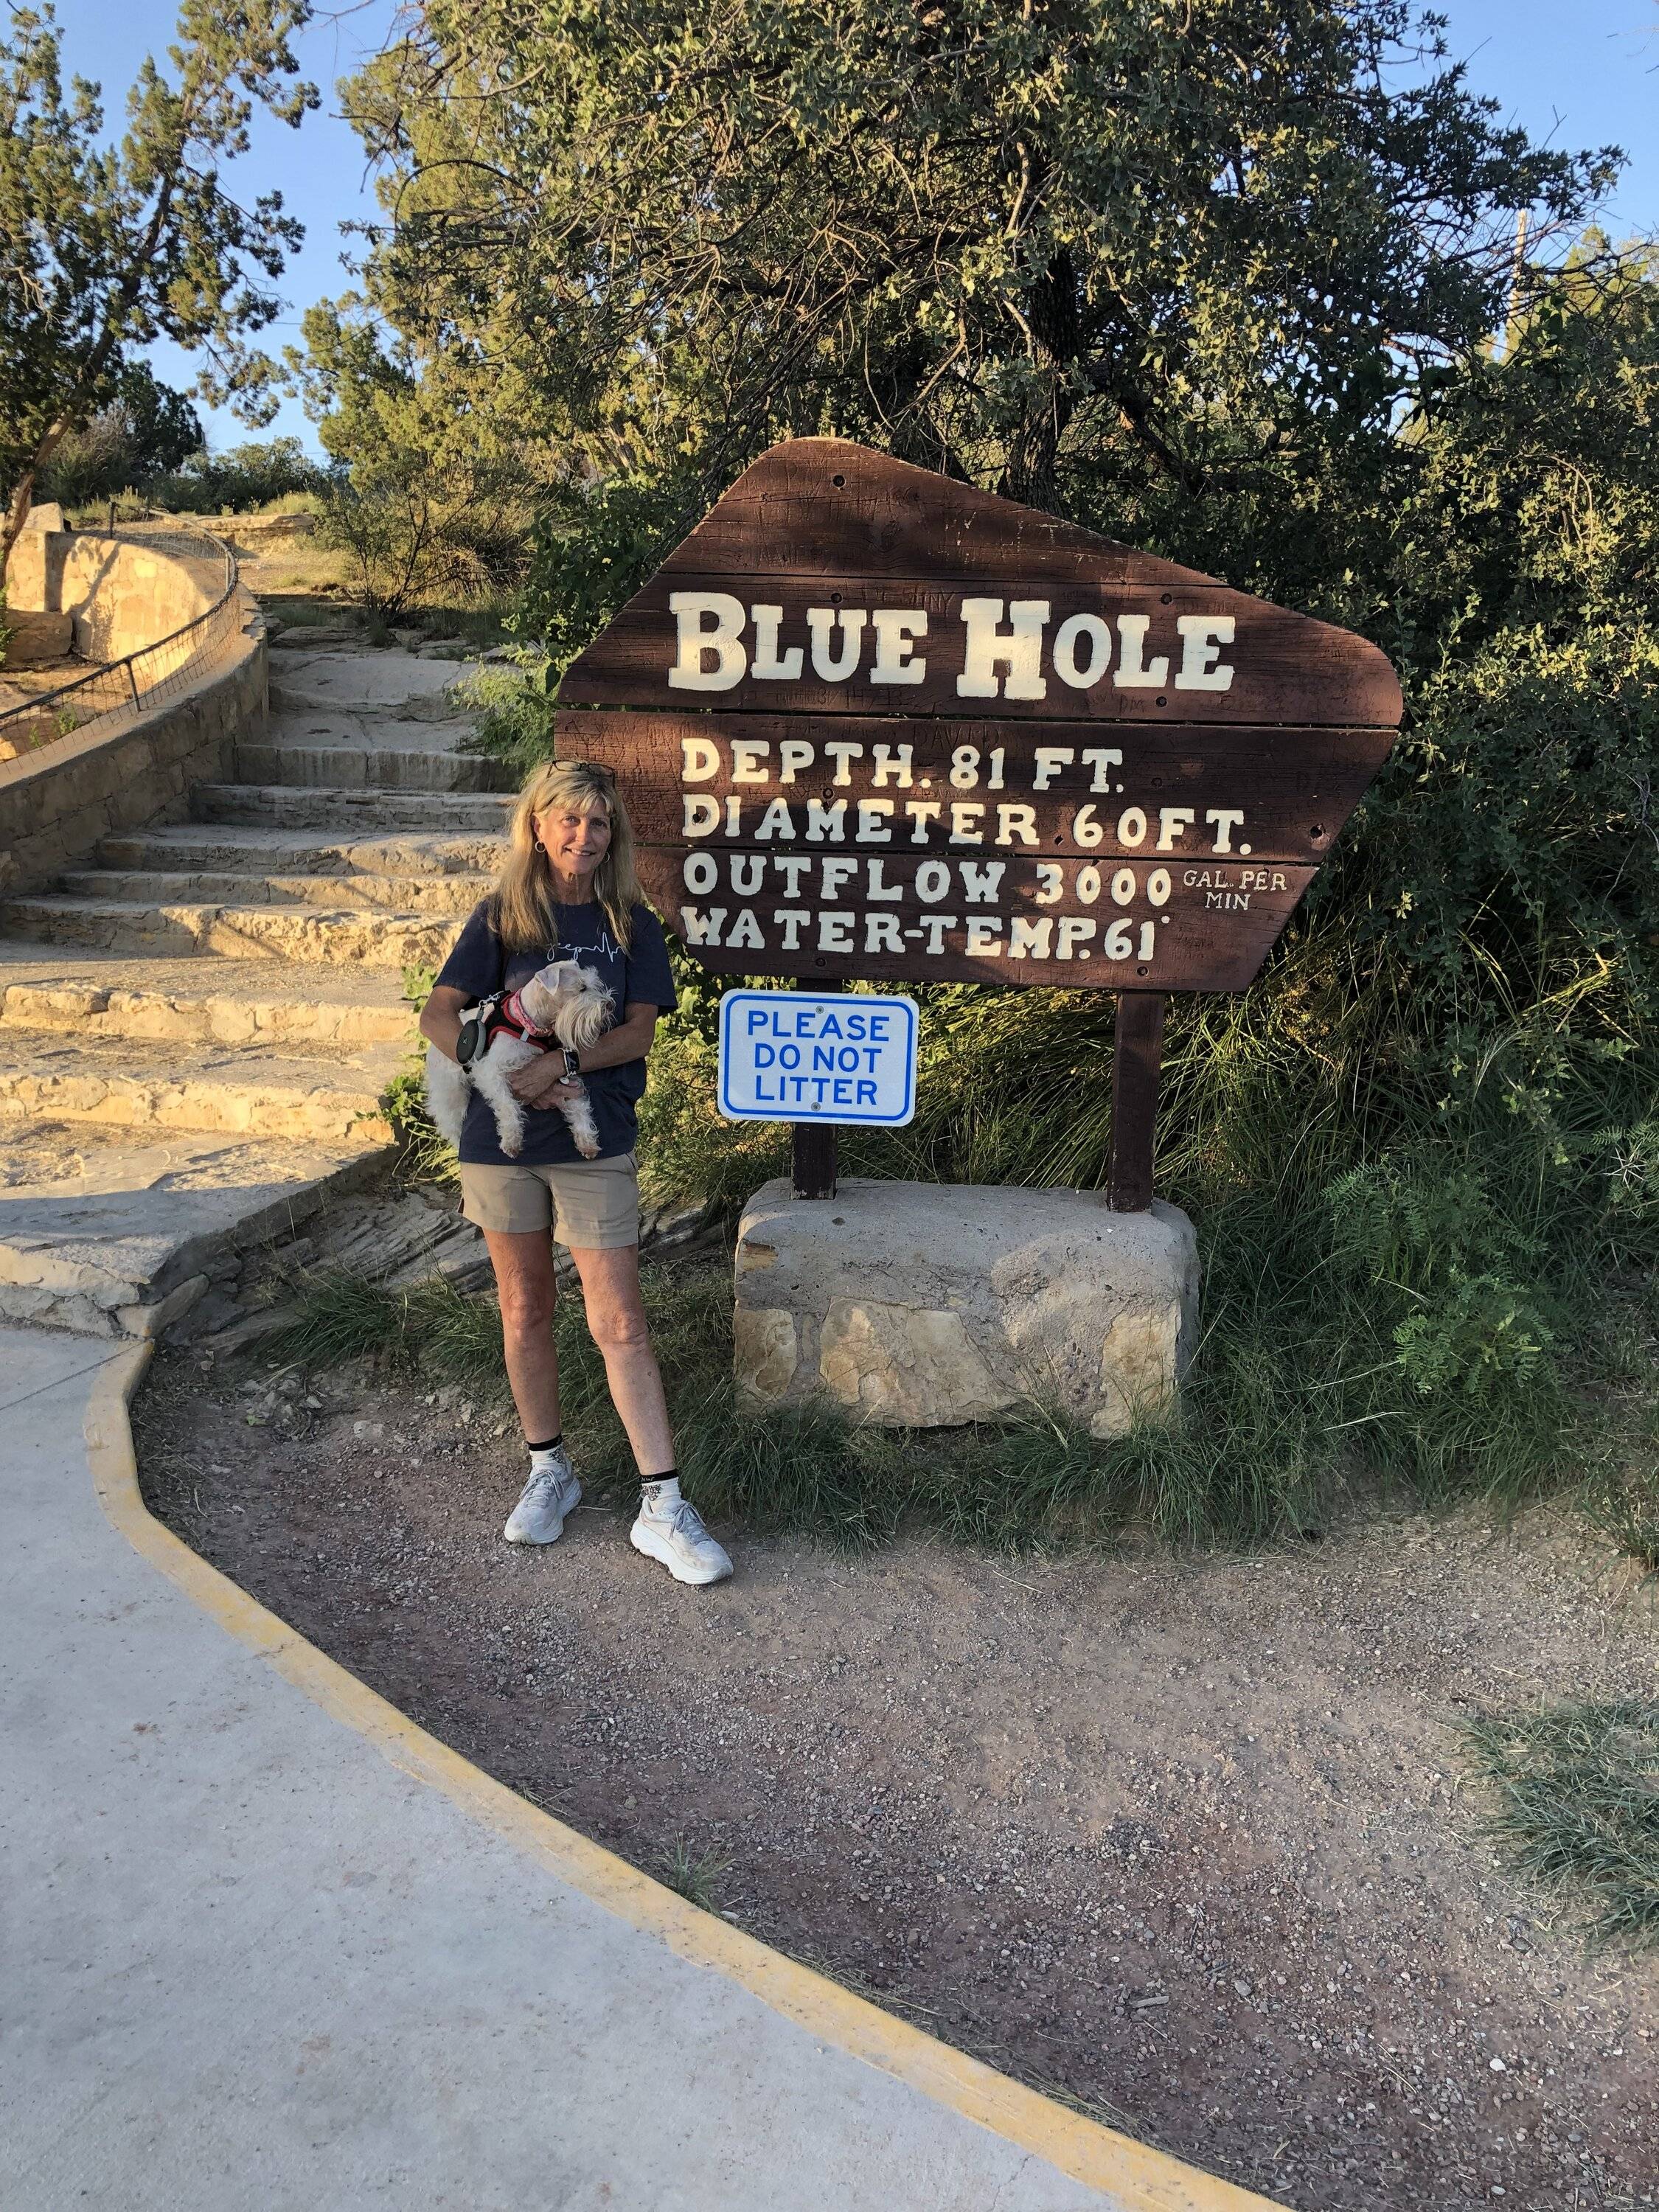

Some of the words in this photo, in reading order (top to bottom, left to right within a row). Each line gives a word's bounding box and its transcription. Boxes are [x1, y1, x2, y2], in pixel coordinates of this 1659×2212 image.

[668, 592, 928, 692] BLUE
[956, 598, 1236, 701] HOLE
[681, 737, 932, 789] DEPTH.
[950, 745, 1005, 790] 81
[1033, 748, 1124, 794] FT.
[682, 793, 1040, 846] DIAMETER
[684, 853, 1006, 904] OUTFLOW
[1034, 863, 1172, 907] 3000
[1239, 870, 1287, 891] PER
[1204, 891, 1251, 911] MIN
[748, 1010, 890, 1042] PLEASE
[754, 1043, 801, 1070] DO
[813, 1046, 882, 1074] NOT
[756, 1075, 877, 1105] LITTER
